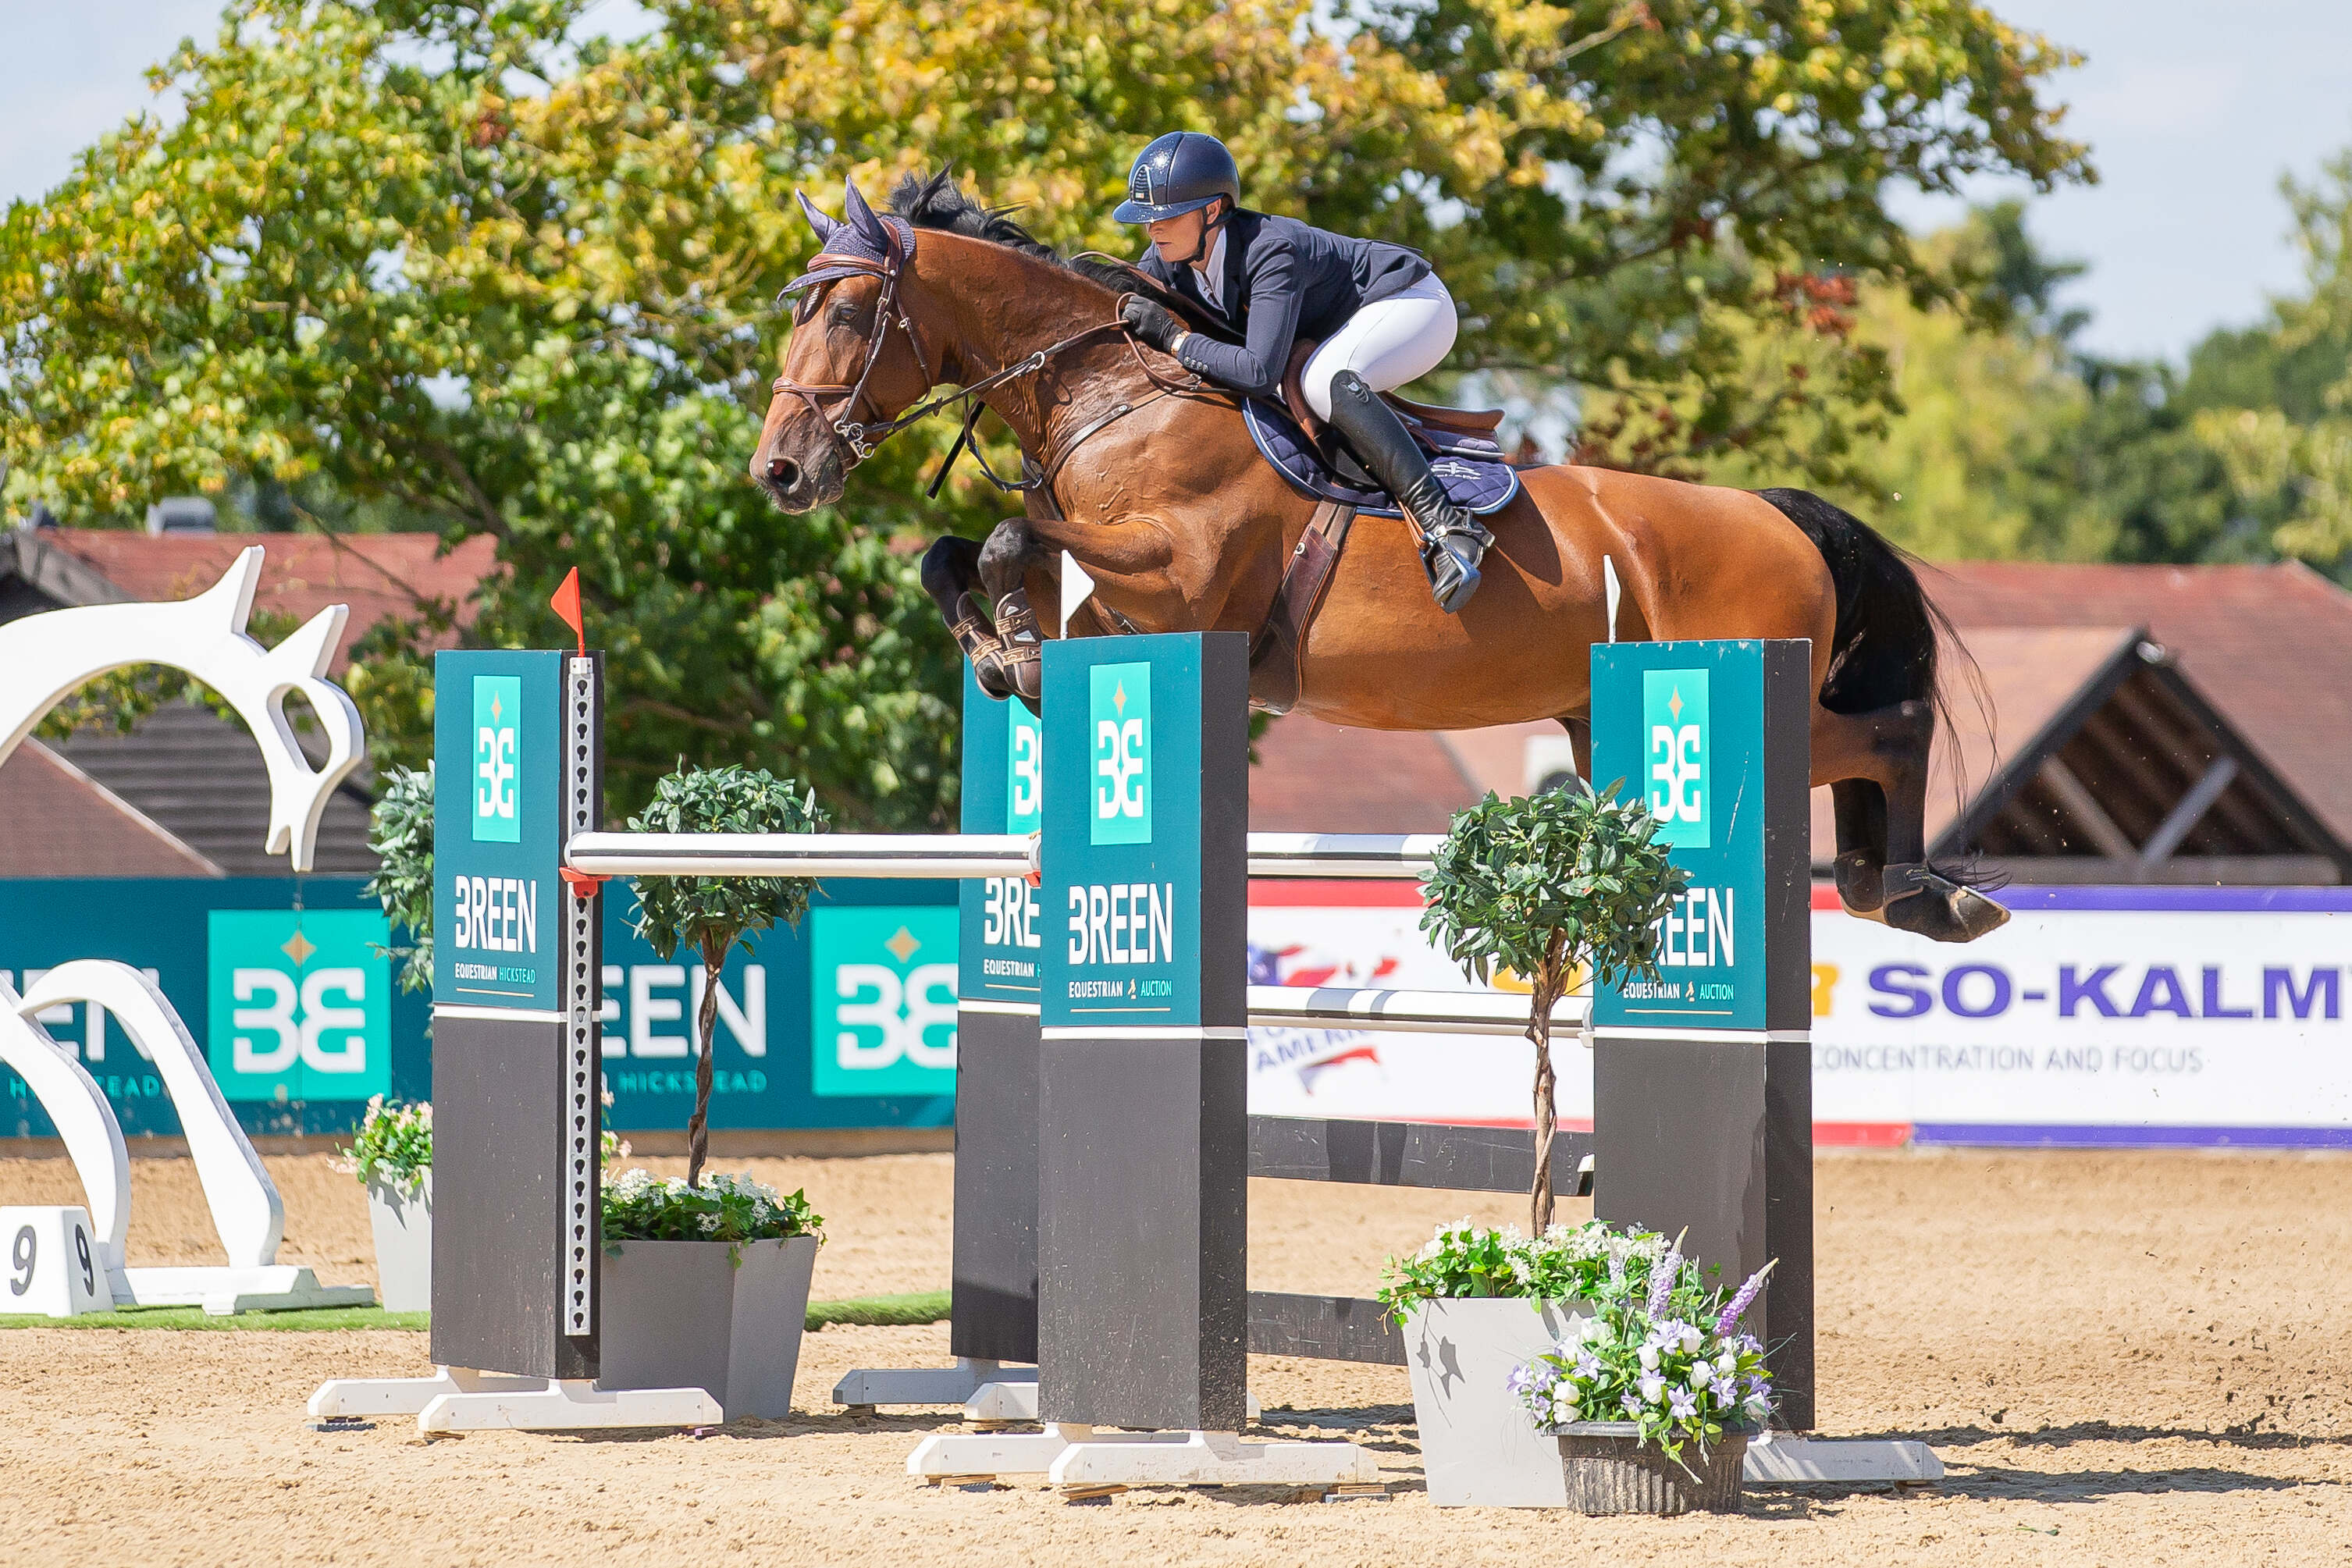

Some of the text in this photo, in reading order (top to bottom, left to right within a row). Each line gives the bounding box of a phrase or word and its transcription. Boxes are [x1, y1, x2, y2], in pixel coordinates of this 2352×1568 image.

[455, 874, 537, 955] BREEN
[984, 877, 1041, 948] BRE
[1069, 883, 1173, 965] BREEN
[455, 962, 536, 984] EQUESTRIAN HICKSTEAD
[984, 958, 1035, 978] EQUESTRIAN
[1069, 979, 1172, 999] EQUESTRIAN AUCTION
[1699, 983, 1735, 1001] AUCTION
[2045, 1047, 2103, 1072] AND
[2114, 1047, 2204, 1074] FOCUS
[617, 1070, 768, 1093] HICKSEAD
[10, 1224, 37, 1296] 9
[75, 1223, 94, 1297] 9
